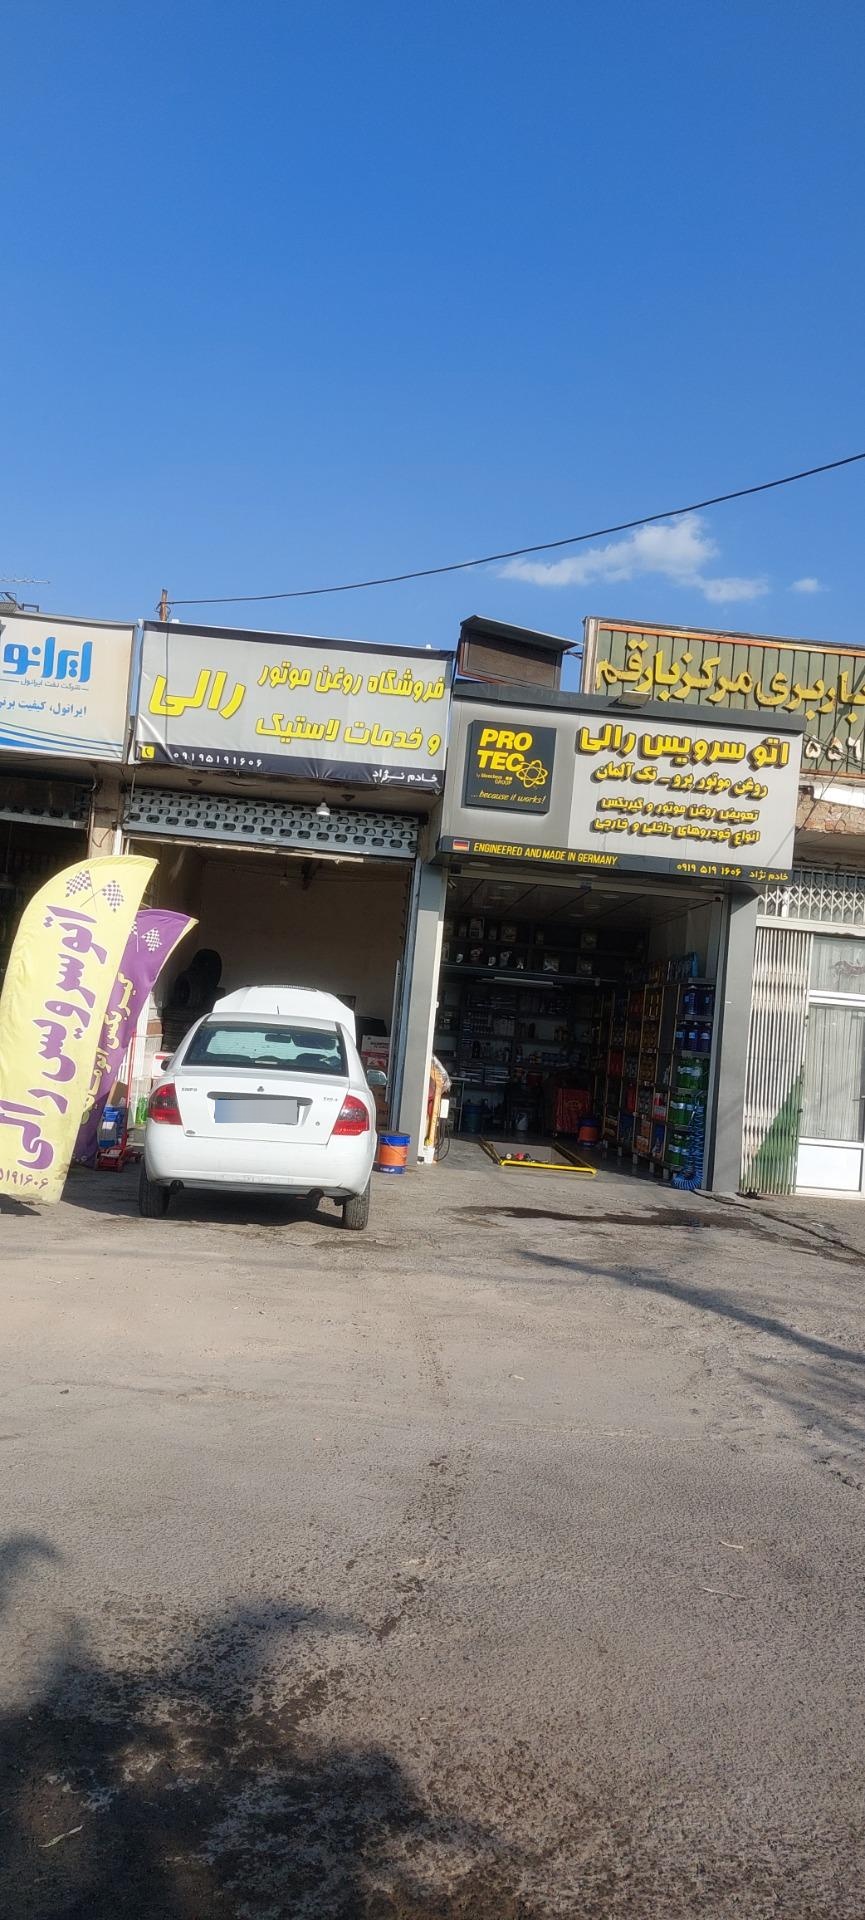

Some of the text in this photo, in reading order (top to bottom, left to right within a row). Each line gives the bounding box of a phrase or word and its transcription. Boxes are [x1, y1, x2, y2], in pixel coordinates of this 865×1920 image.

[3, 636, 93, 683] ایرانو
[258, 661, 446, 702] فروشگاه روغن موتور
[149, 668, 246, 719] رالی
[18, 699, 46, 712] کیفیت
[255, 713, 441, 756] و خدمات لاستیک
[479, 728, 533, 751] PRO
[580, 724, 790, 767] اتو سرویس رالی
[173, 752, 262, 768] ۰۹۱۹۵۱۹۱۶۰۶
[477, 749, 525, 772] TEC
[372, 769, 438, 784] خادم نژاد
[595, 761, 634, 780] آلمان
[636, 766, 658, 781] تک
[698, 772, 731, 790] موتور
[734, 778, 768, 797] روغن
[518, 794, 547, 804] works!
[646, 802, 654, 813] و
[656, 803, 686, 816] موتور
[689, 804, 716, 818] روغن
[719, 808, 760, 822] تعویض
[594, 817, 760, 846] انواع خودروهای داخلی و خارجی
[473, 842, 618, 866] ENGINEERED AND MADE IN GERMANY
[676, 863, 742, 877] ۰۹۱۹ ۵۱۹ ۱۶۰۶
[748, 870, 789, 881] خادم نژاد
[43, 905, 108, 965] اتو
[32, 953, 97, 1082] سرویس
[0, 1168, 49, 1189] ۱۹۱۶۰۶
